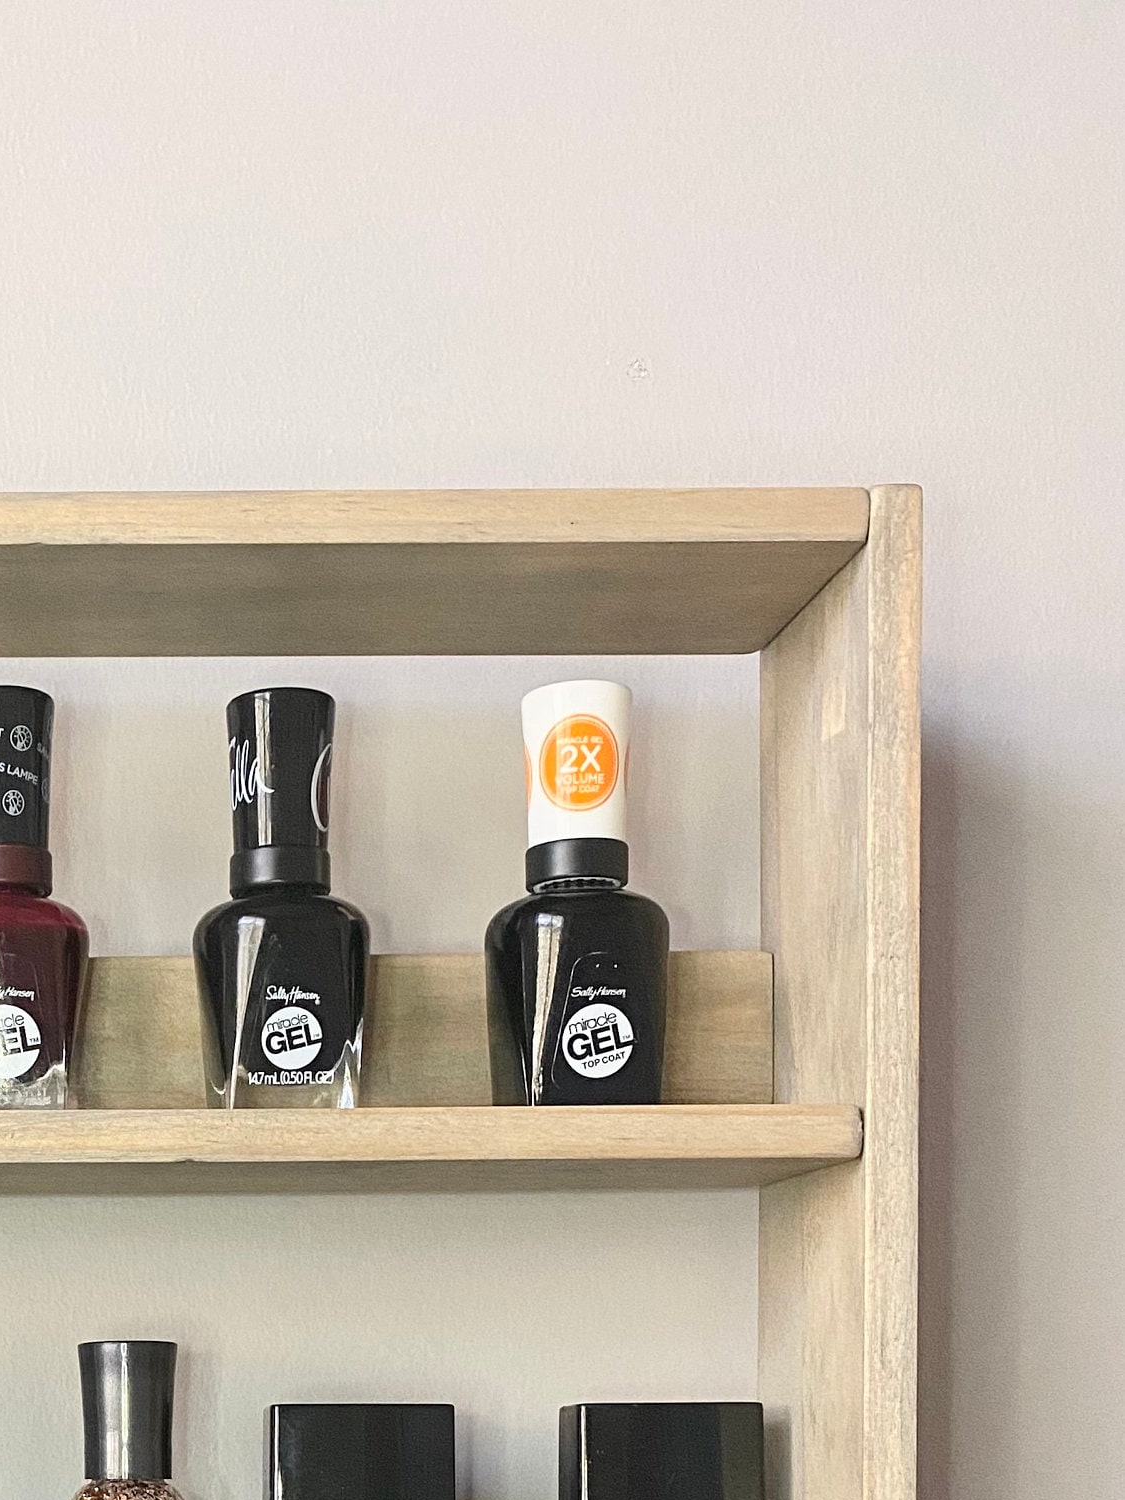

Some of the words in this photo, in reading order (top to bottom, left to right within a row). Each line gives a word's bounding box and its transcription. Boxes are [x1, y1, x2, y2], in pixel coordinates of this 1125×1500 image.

[559, 745, 602, 773] 2X
[6, 764, 38, 785] LAMPE
[4, 986, 34, 1001] Hansen
[266, 985, 289, 1005] Sally
[287, 986, 320, 1004] Hansen
[571, 986, 596, 1001] Sally
[595, 986, 626, 998] Hansen
[267, 1014, 308, 1032] miracle
[568, 1012, 617, 1034] miracle
[266, 1023, 323, 1055] GEL
[567, 1022, 636, 1060] GEL
[581, 1058, 601, 1069] TOP
[601, 1051, 626, 1064] COAT
